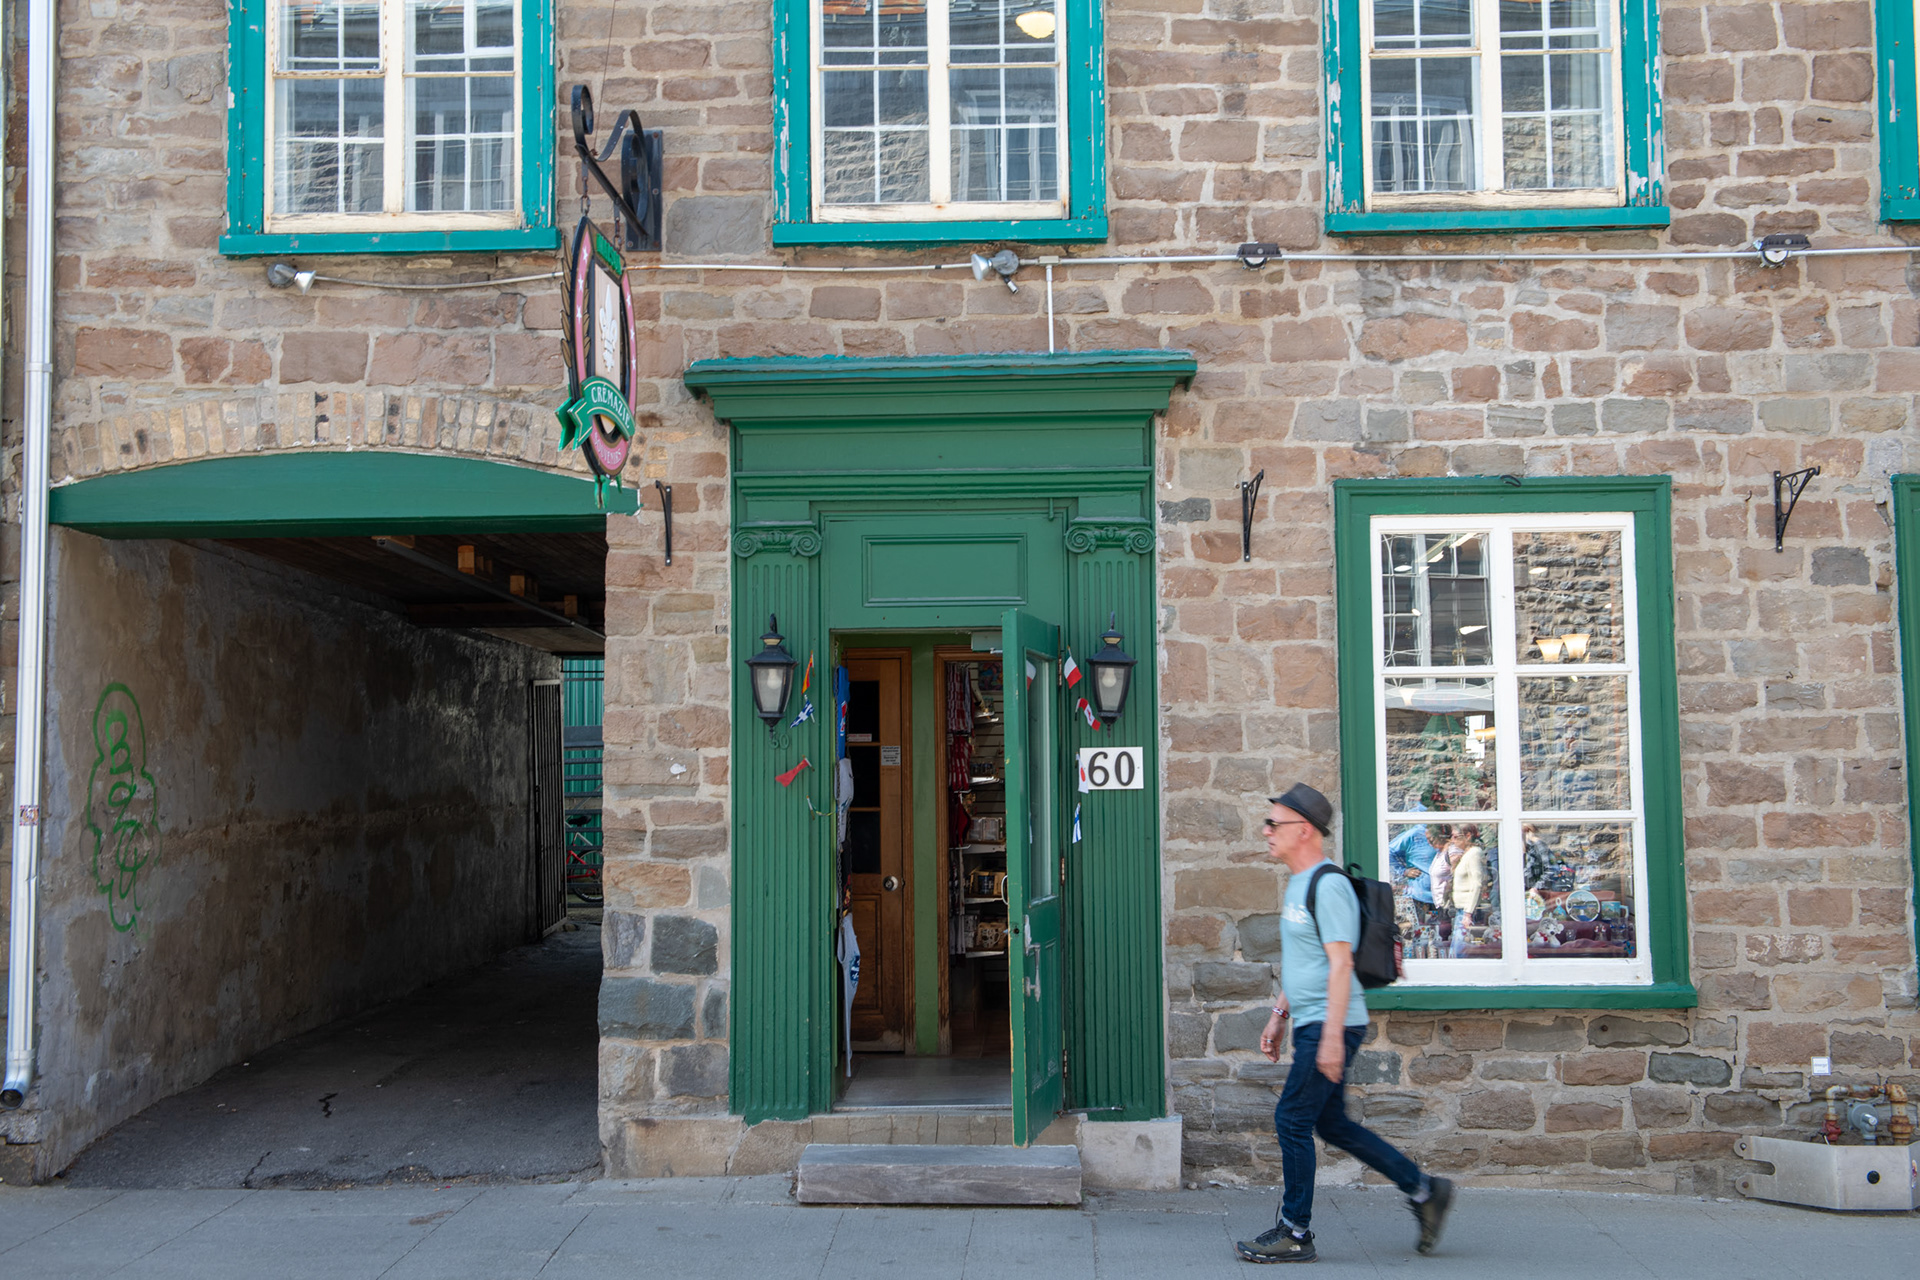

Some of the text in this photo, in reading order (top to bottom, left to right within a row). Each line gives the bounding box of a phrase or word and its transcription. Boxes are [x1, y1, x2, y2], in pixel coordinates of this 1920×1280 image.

[591, 383, 630, 428] CRÉMAZIE
[594, 432, 622, 465] SOUVENIRS
[1088, 751, 1135, 787] 60
